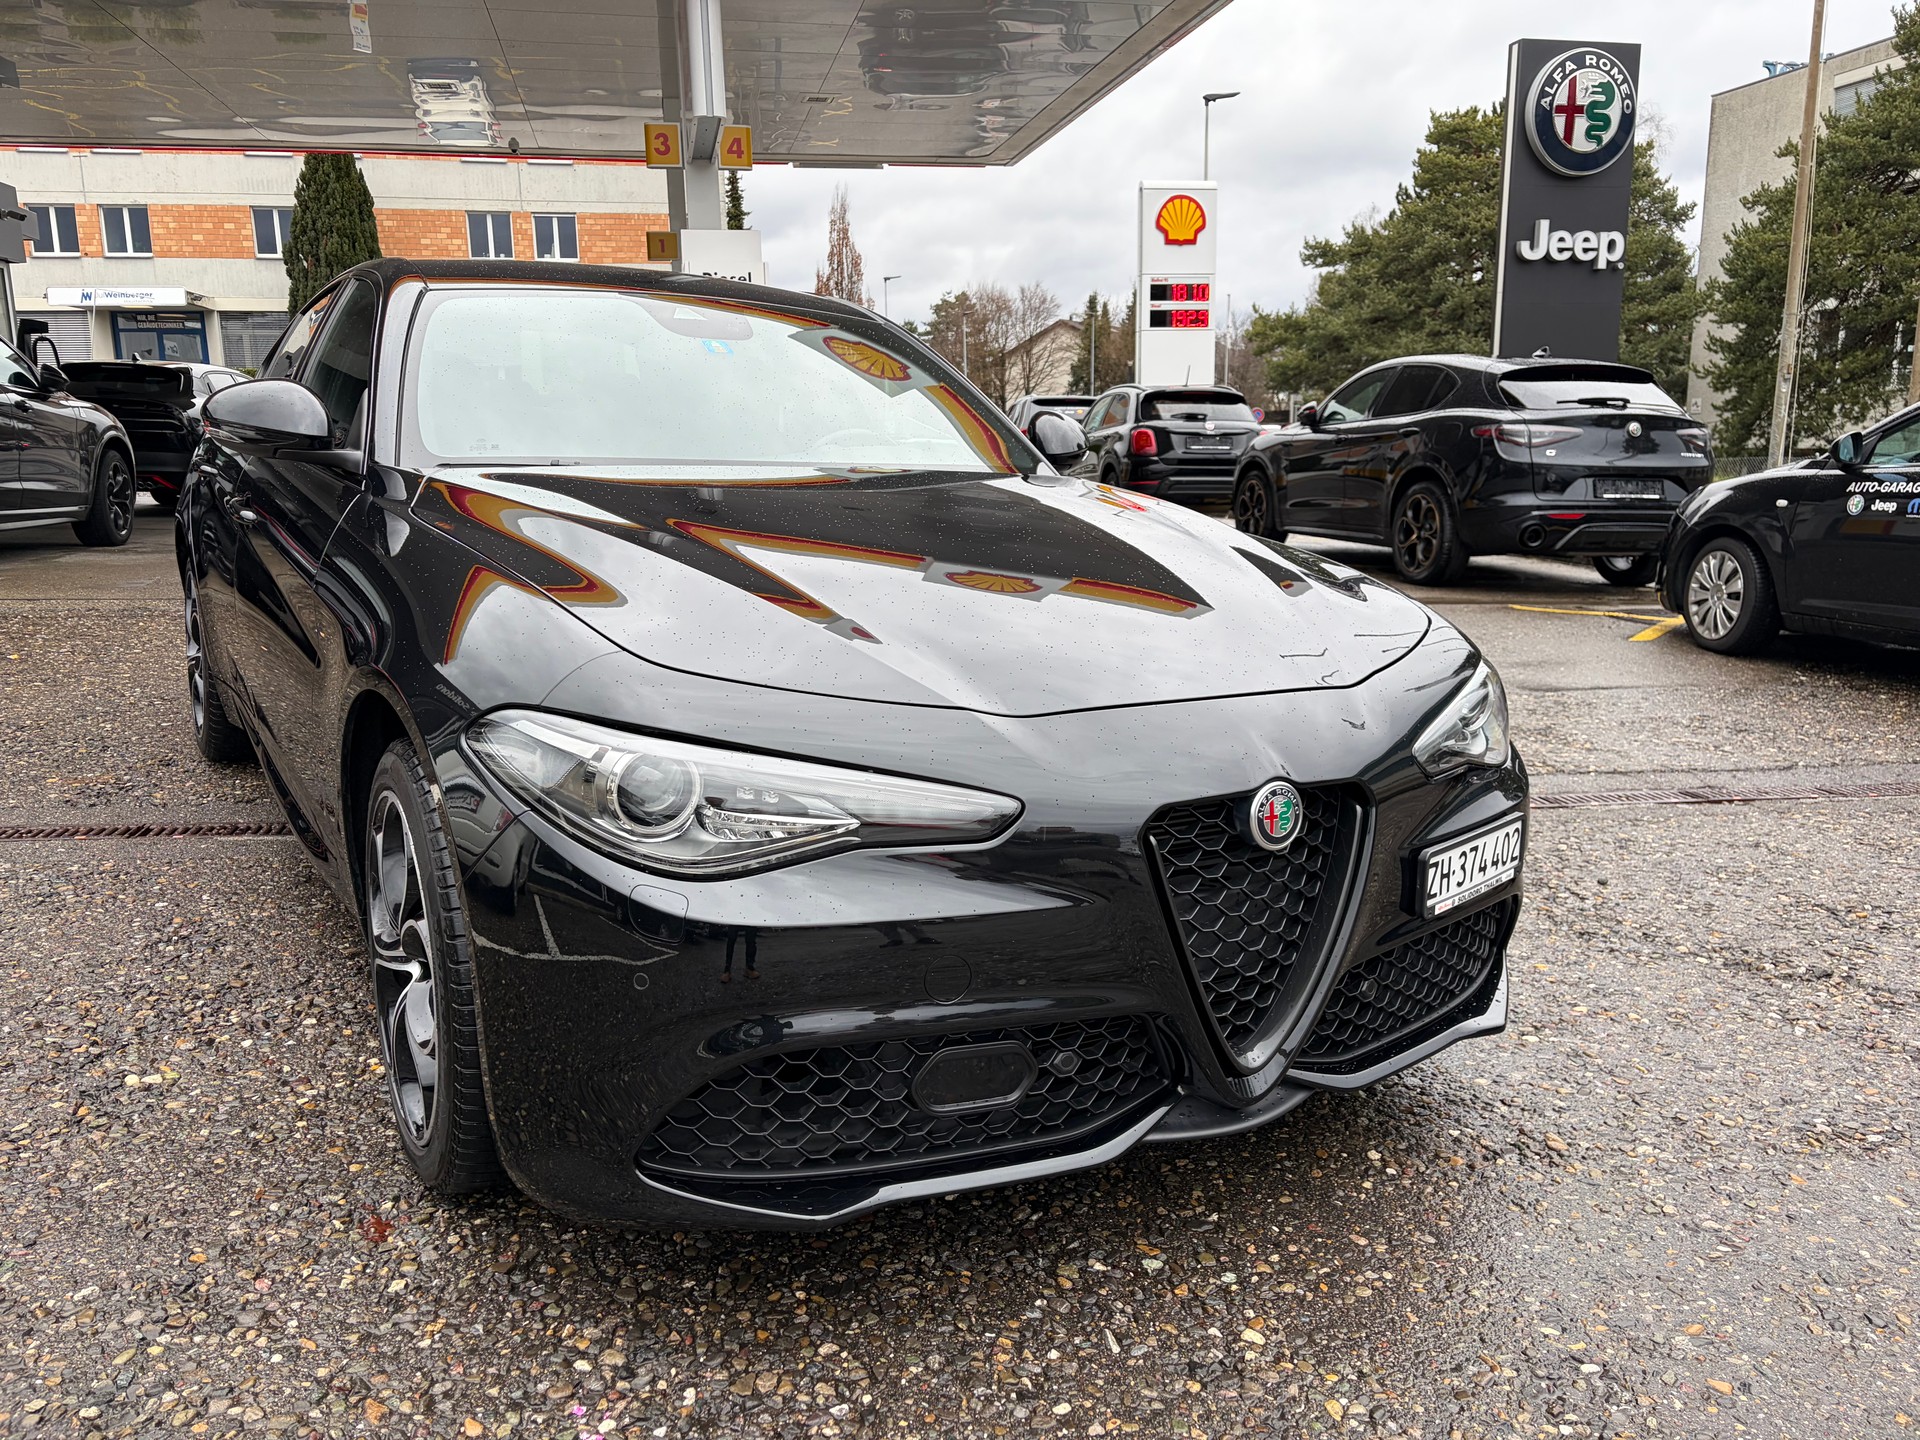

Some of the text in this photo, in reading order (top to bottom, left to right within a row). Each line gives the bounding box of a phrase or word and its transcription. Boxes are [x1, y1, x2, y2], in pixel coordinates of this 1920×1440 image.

[1540, 54, 1633, 115] ALFA ROMEO
[653, 132, 671, 156] 3
[726, 137, 745, 159] 4
[657, 238, 666, 253] 1
[1516, 218, 1625, 270] Jeep
[1870, 499, 1898, 513] Jeep
[1258, 793, 1274, 819] ALFA
